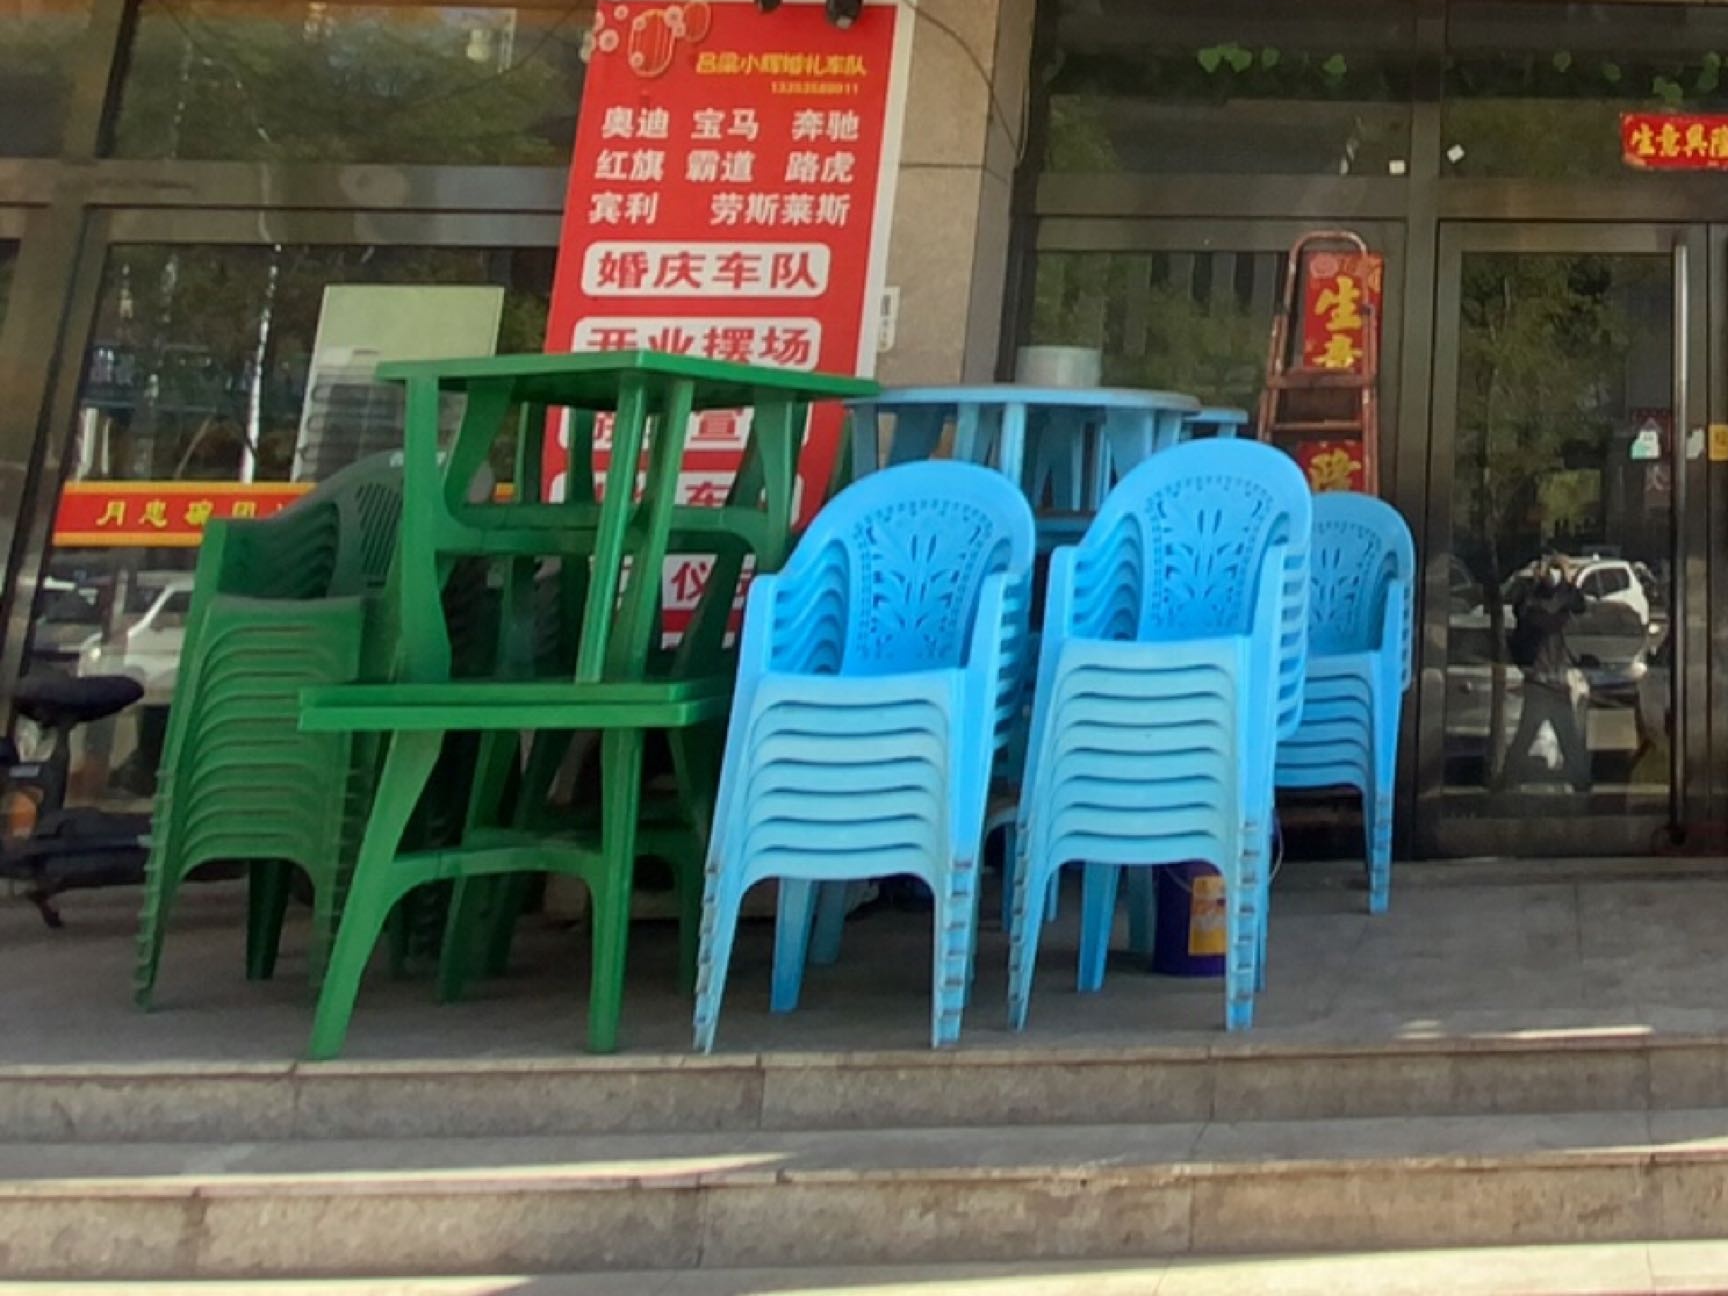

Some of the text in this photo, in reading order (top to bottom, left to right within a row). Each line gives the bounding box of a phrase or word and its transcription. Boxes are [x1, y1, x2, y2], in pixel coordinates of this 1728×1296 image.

[602, 106, 860, 142] 奥迪 宝马 奔驰
[594, 149, 856, 184] 红旗 霸道 路虎
[589, 190, 851, 227] 宾利 劳斯莱斯
[596, 249, 818, 290] 婚庆车队
